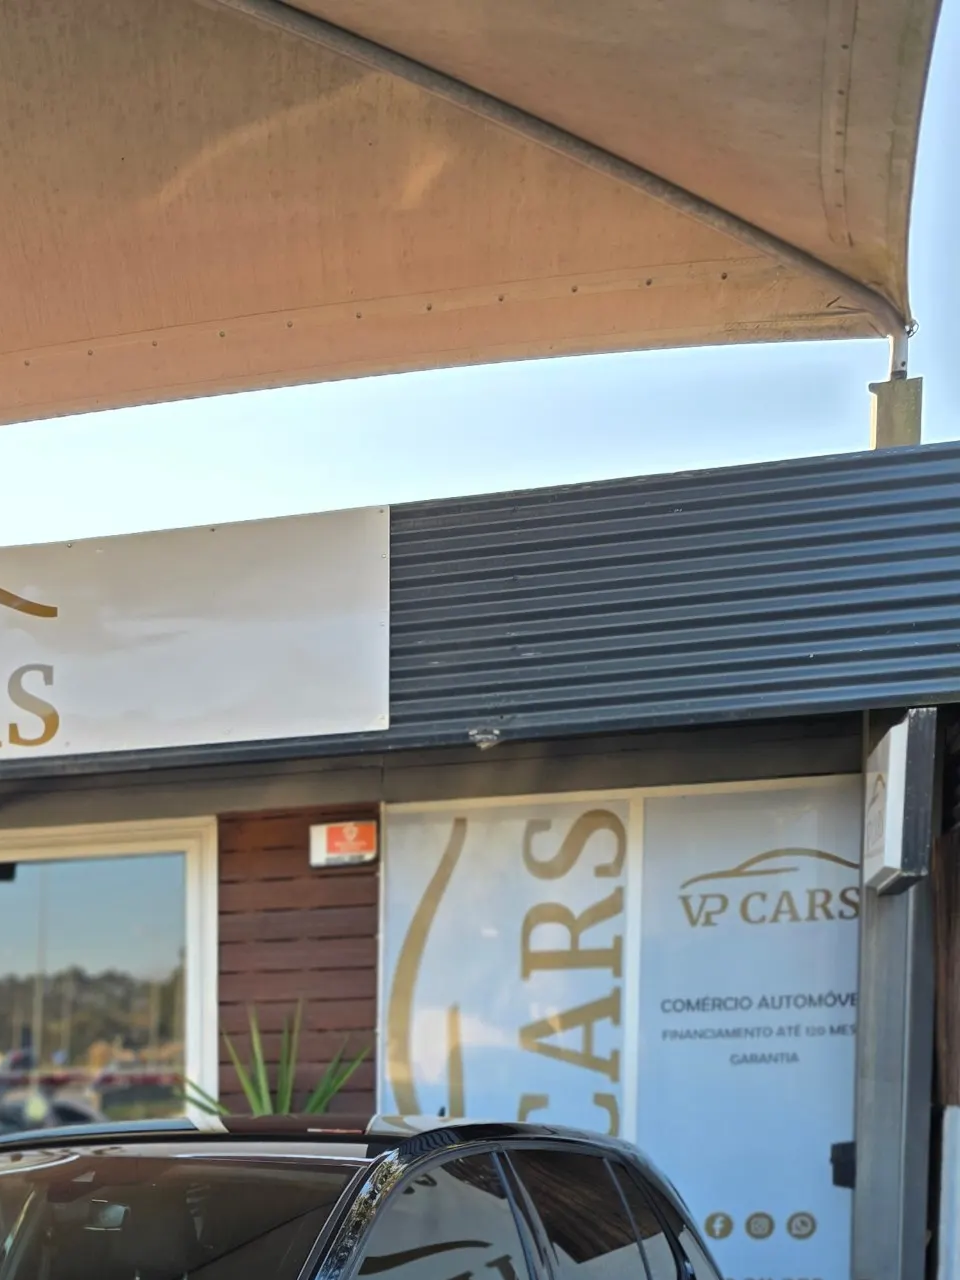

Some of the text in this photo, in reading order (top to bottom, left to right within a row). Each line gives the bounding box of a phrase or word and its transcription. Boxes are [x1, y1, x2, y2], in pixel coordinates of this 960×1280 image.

[678, 886, 860, 928] VP CARS
[660, 994, 753, 1014] COMÉRCIO
[661, 1025, 773, 1041] FINANCIAMENTO
[776, 1024, 801, 1038] ATÉ
[805, 1025, 826, 1037] 120
[729, 1052, 800, 1067] GARANTIA
